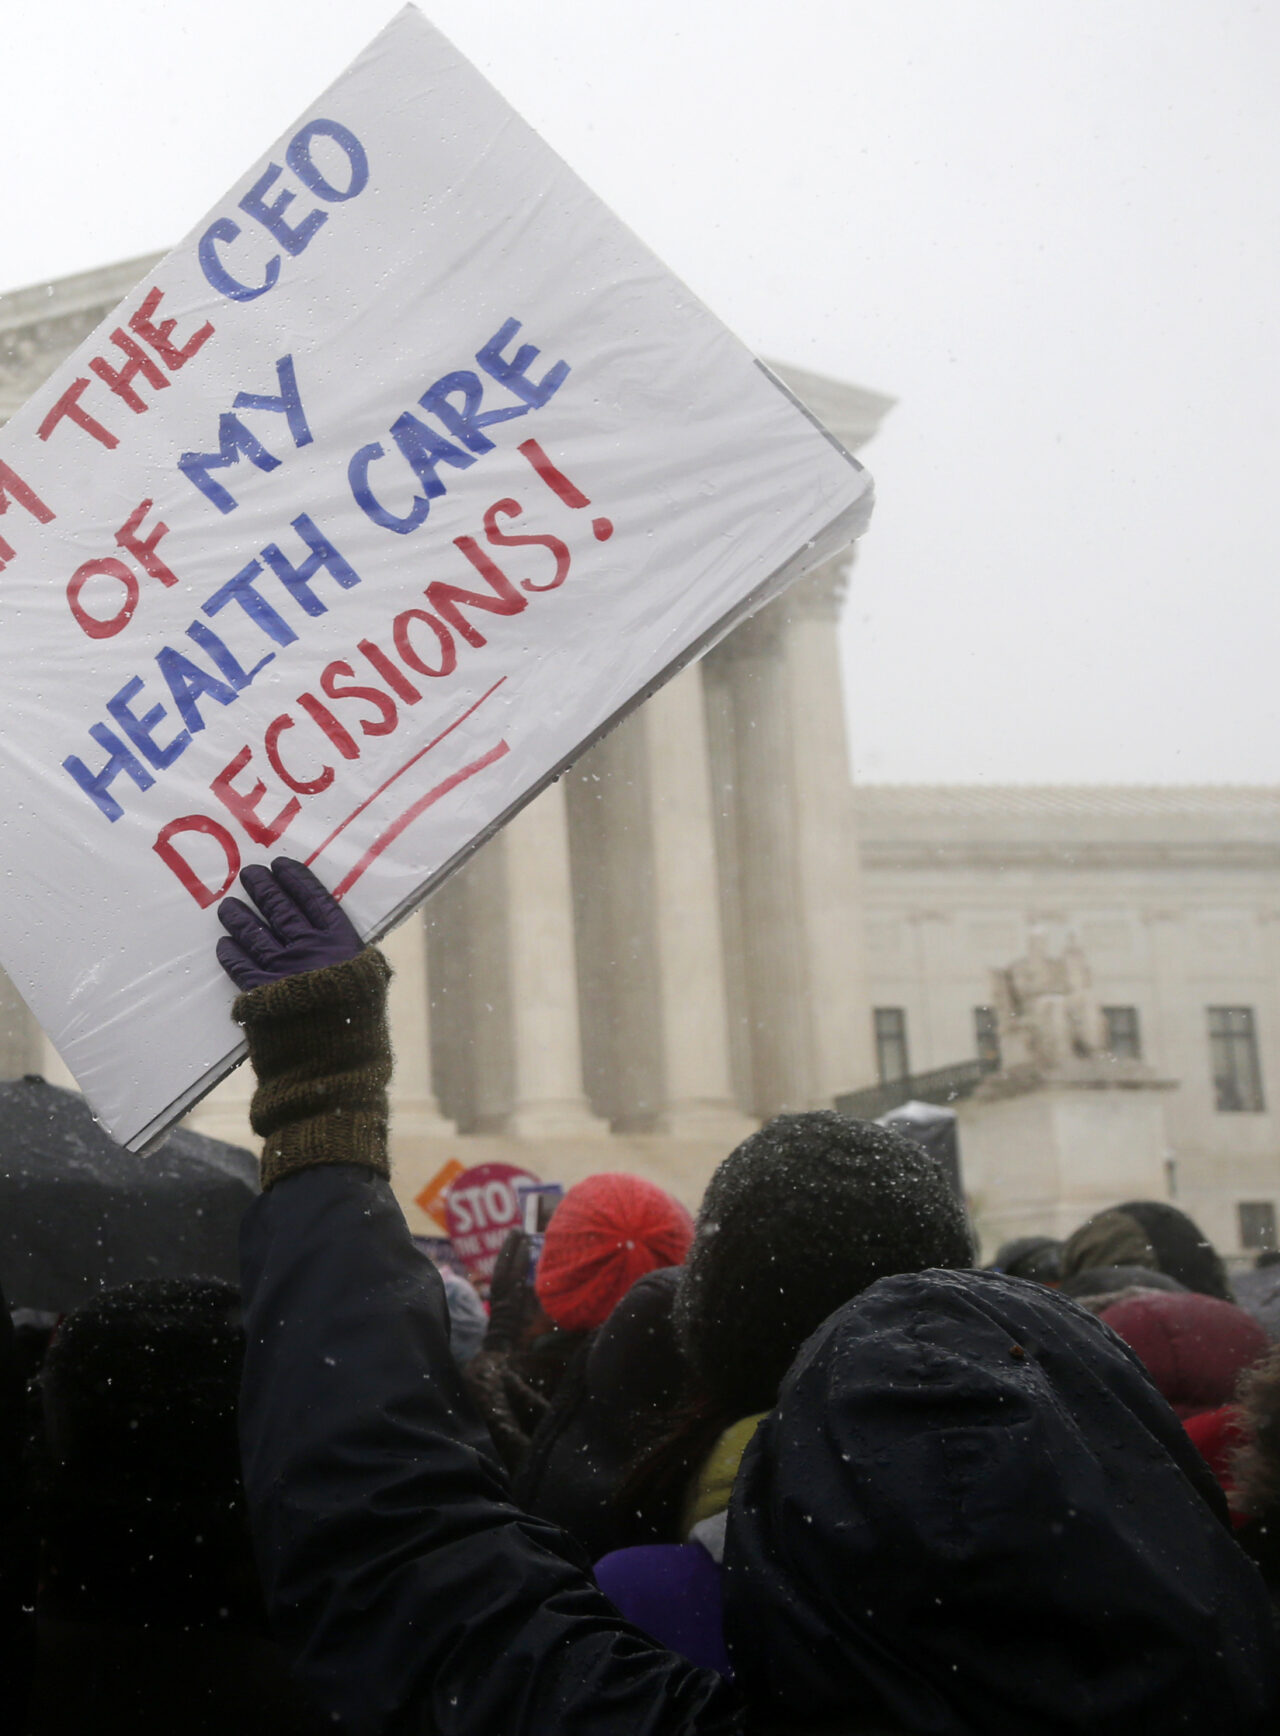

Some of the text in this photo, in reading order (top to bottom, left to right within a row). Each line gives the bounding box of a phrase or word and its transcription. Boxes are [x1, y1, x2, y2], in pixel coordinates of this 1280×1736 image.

[36, 286, 215, 449] THE
[198, 118, 369, 302] CEO
[62, 317, 572, 823] HEALTH CARE
[66, 354, 314, 639] OF MY
[152, 438, 613, 910] DECISIONS!
